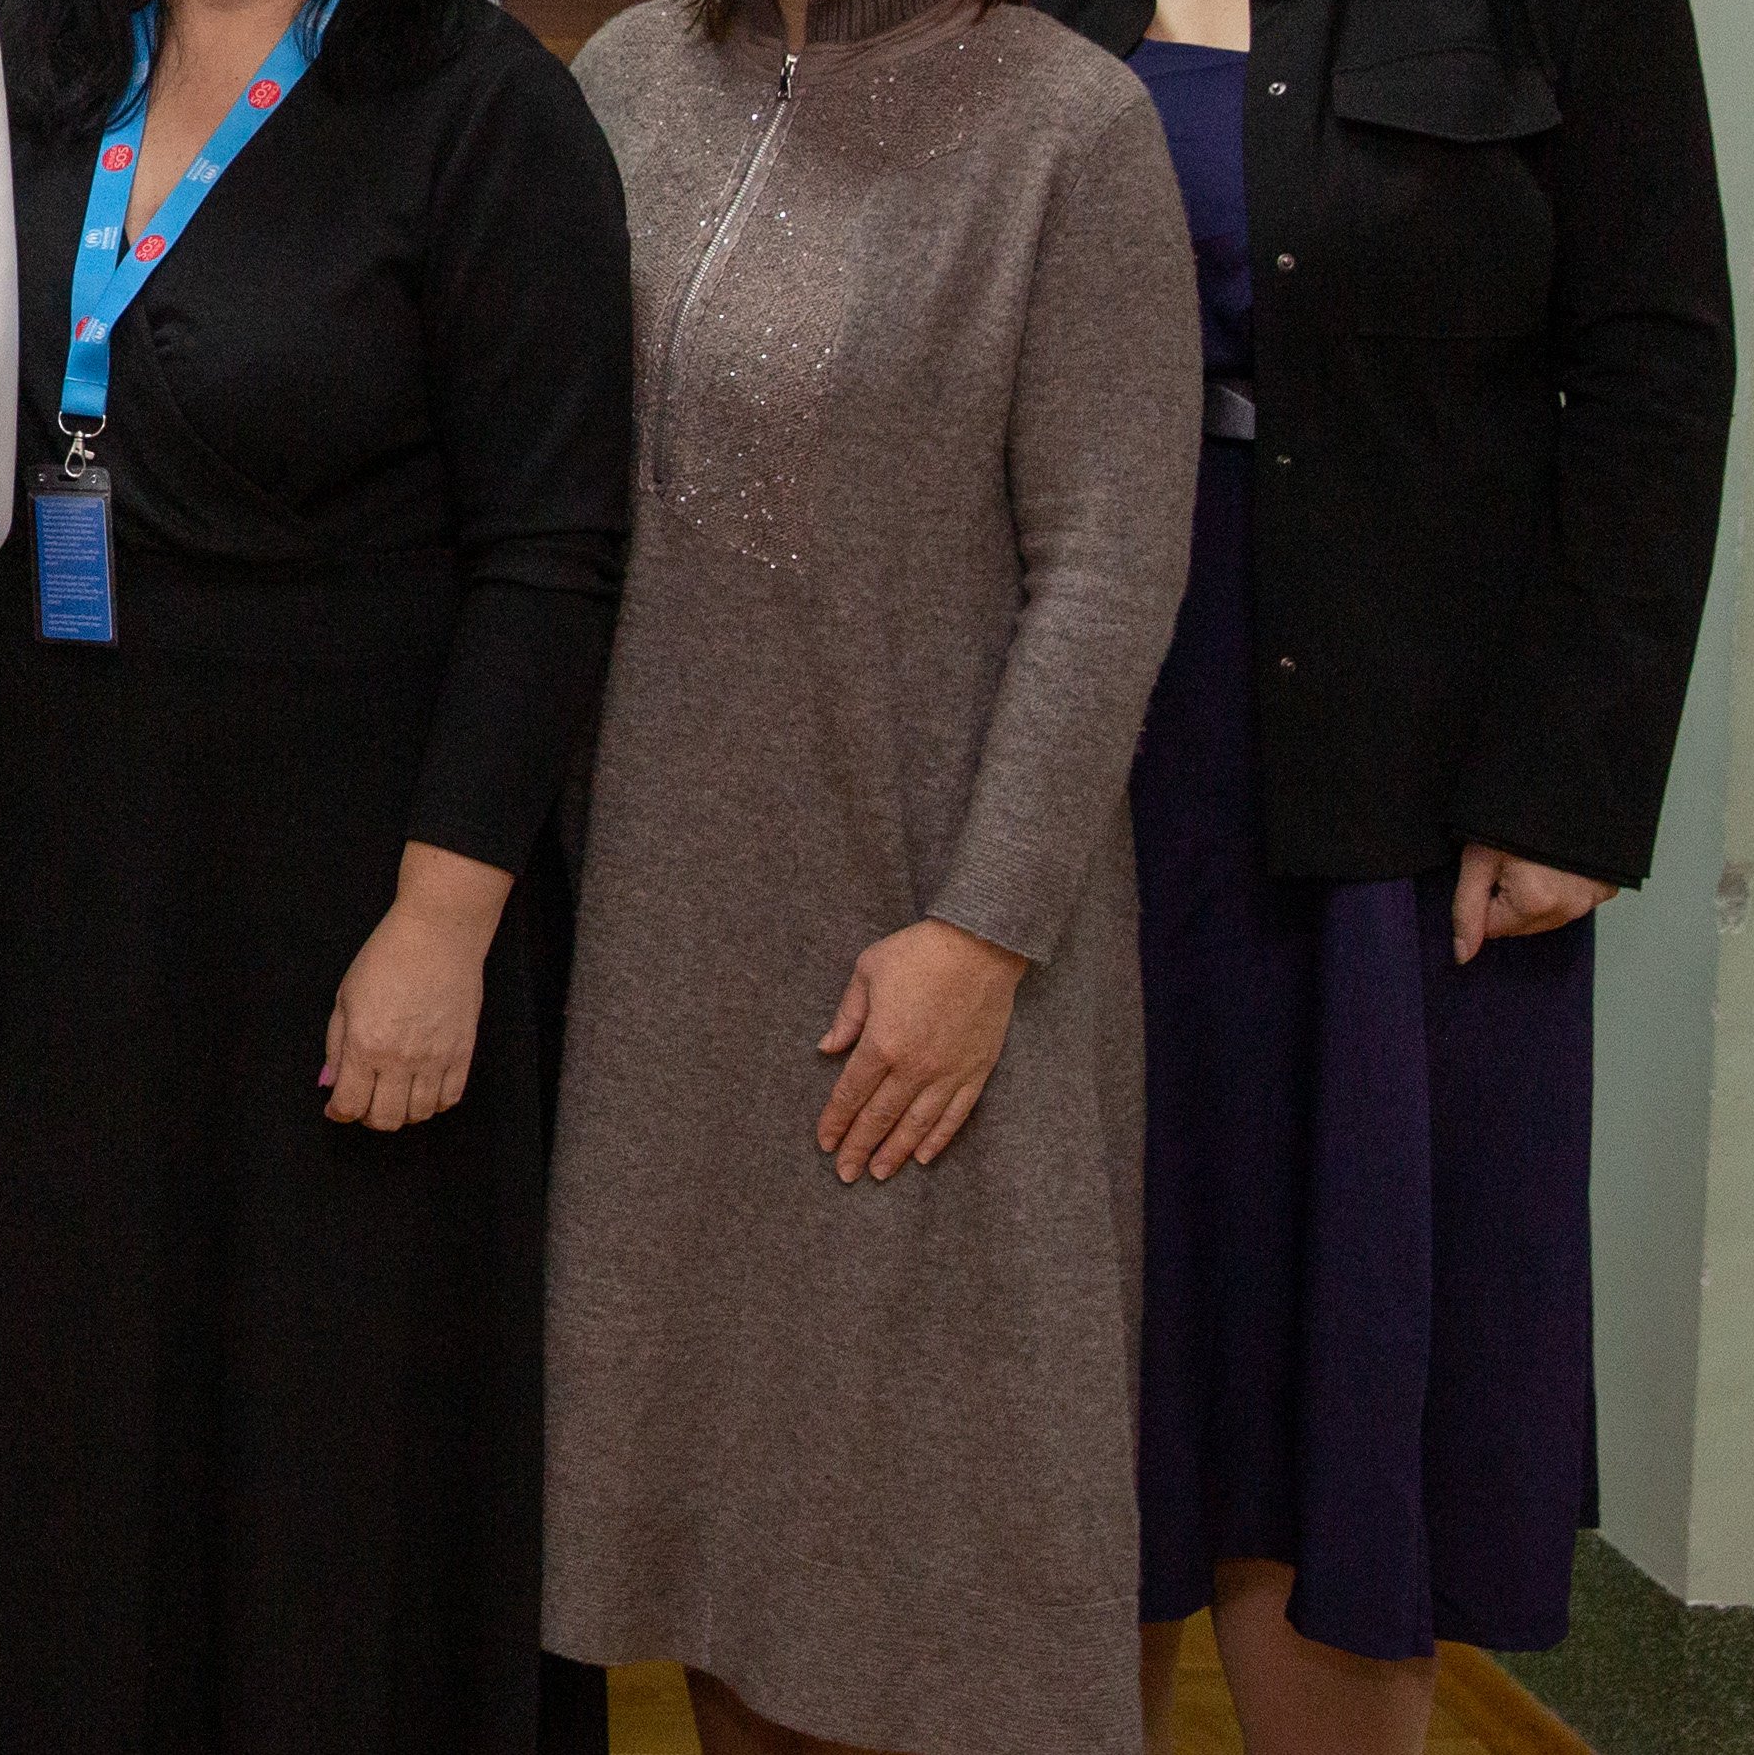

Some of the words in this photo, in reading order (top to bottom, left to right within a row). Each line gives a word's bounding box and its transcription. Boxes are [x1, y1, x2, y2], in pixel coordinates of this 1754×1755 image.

[251, 80, 271, 106] SOS
[114, 146, 129, 169] SOS
[136, 236, 159, 260] SOS
